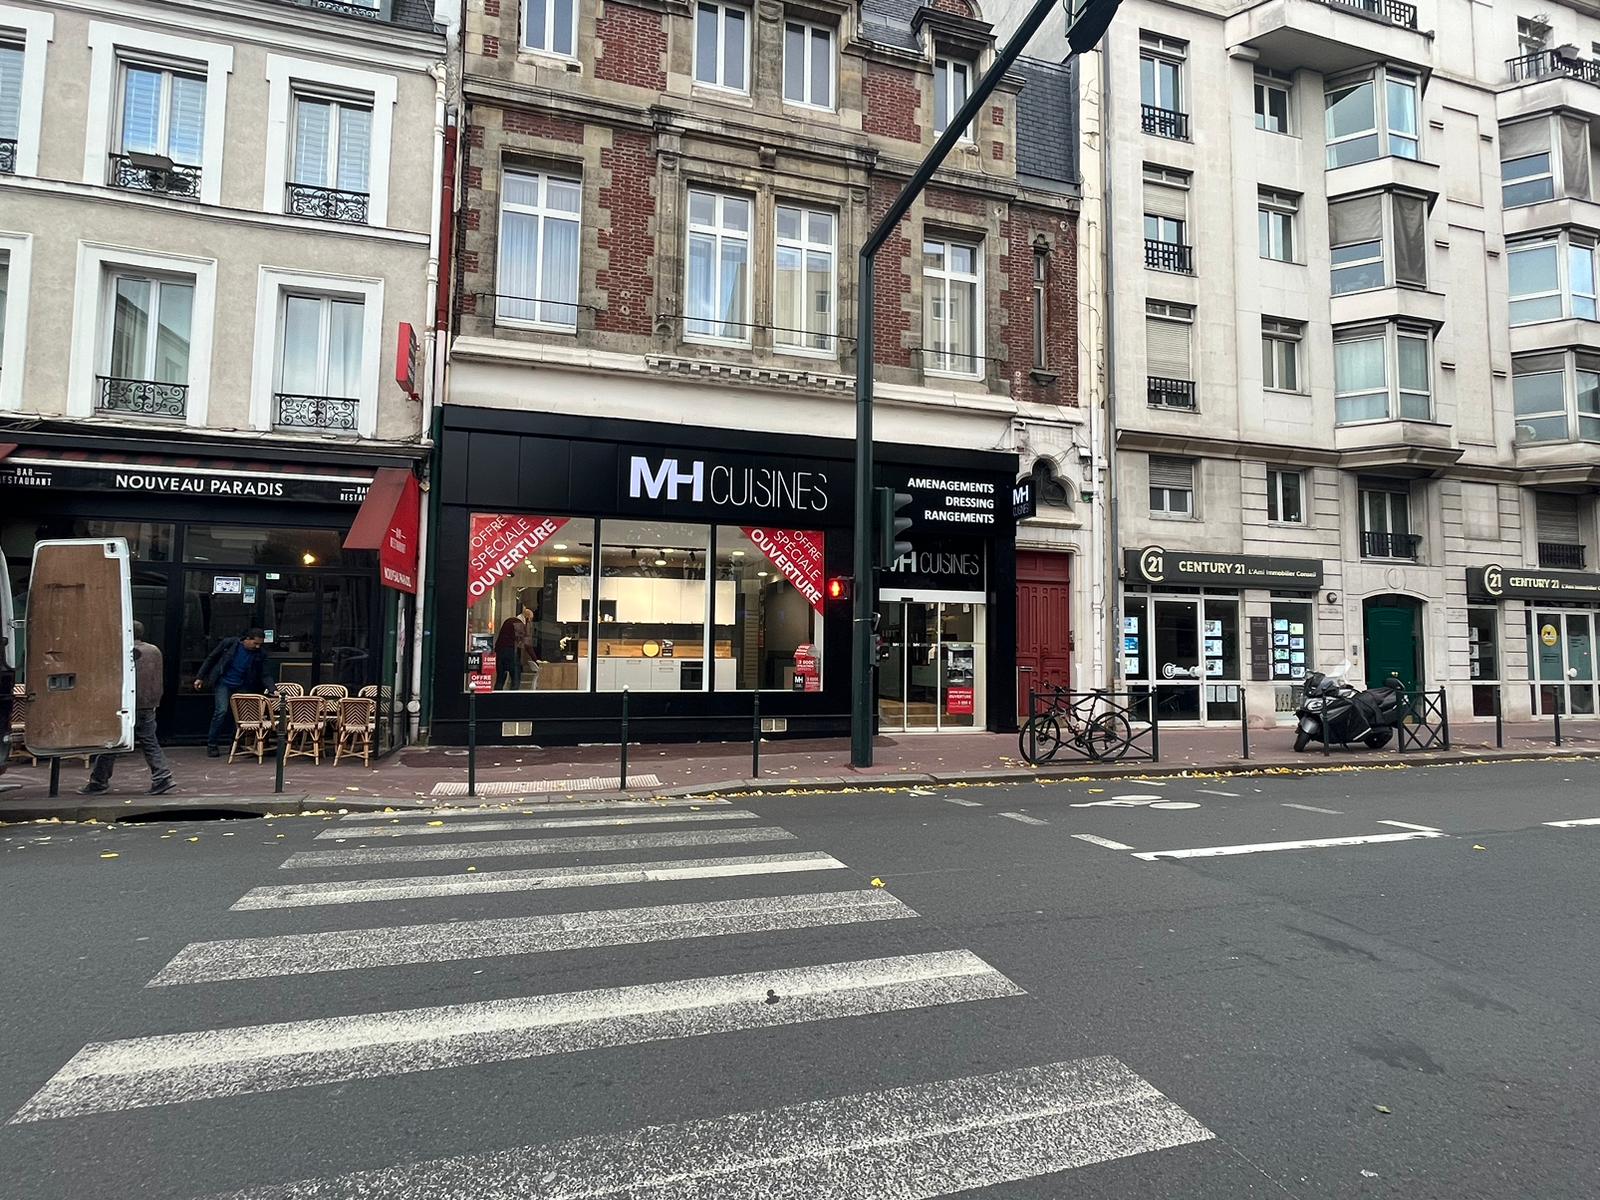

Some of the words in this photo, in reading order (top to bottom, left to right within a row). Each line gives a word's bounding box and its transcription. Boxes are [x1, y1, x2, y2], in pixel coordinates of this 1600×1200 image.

[16, 467, 33, 476] BAR
[115, 474, 204, 492] NOUVEAU
[210, 479, 283, 496] PARADIS
[629, 456, 704, 501] MH
[710, 465, 828, 511] CUISINES
[907, 477, 994, 494] AMENAGEMENTS
[1012, 484, 1030, 506] MH
[945, 496, 994, 509] DRESSING
[924, 509, 995, 524] RANGEMENTS
[471, 515, 507, 548] OFFRE
[471, 517, 530, 571] SPÉCIALE
[793, 530, 822, 561] OFFRE
[469, 518, 557, 596] OUVERTURE
[751, 529, 822, 605] OUVERTURE
[773, 530, 821, 582] SPÉCIALE
[920, 551, 980, 575] CUISINES
[1178, 560, 1233, 575] CENTURY
[1234, 563, 1246, 575] 21
[1509, 577, 1550, 589] CENTURY
[1551, 579, 1560, 589] 21
